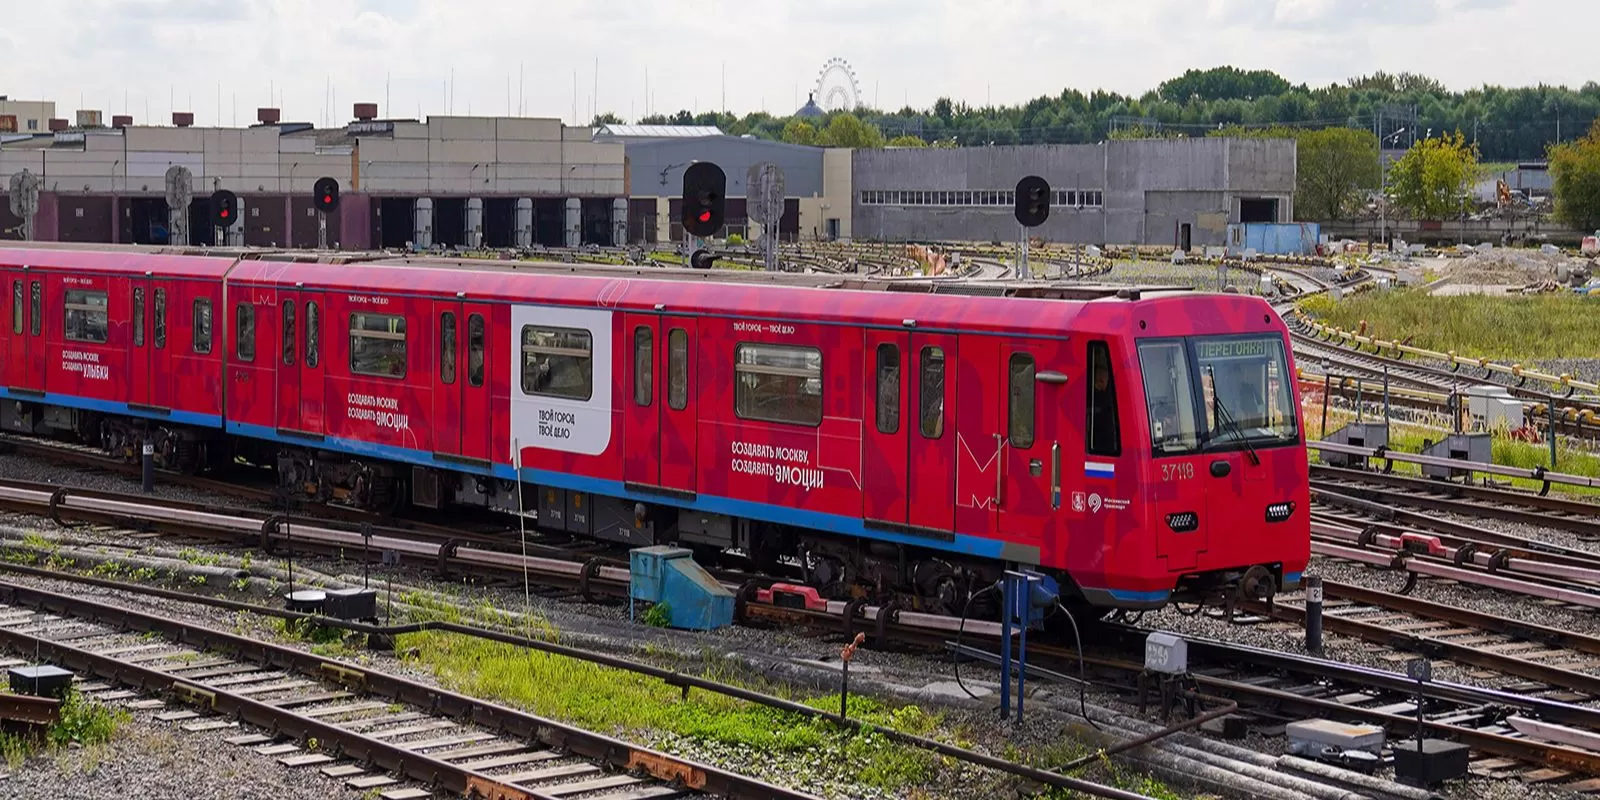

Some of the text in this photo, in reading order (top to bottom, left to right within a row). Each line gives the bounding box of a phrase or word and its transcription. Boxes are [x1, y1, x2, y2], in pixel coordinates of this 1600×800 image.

[1200, 342, 1264, 357] ПЕРЕГОНКА
[376, 410, 409, 432] ЭМОЦИИ
[539, 409, 575, 425] ТВОЙ ГОРОД
[539, 424, 570, 439] ТВОЁ ДЕЛО
[731, 441, 809, 465] СОЗДАВАТЬ МОСКВУ,
[731, 458, 824, 491] СОЗДАВАТЬ ЭМОЦИИ
[1161, 462, 1194, 481] 37118
